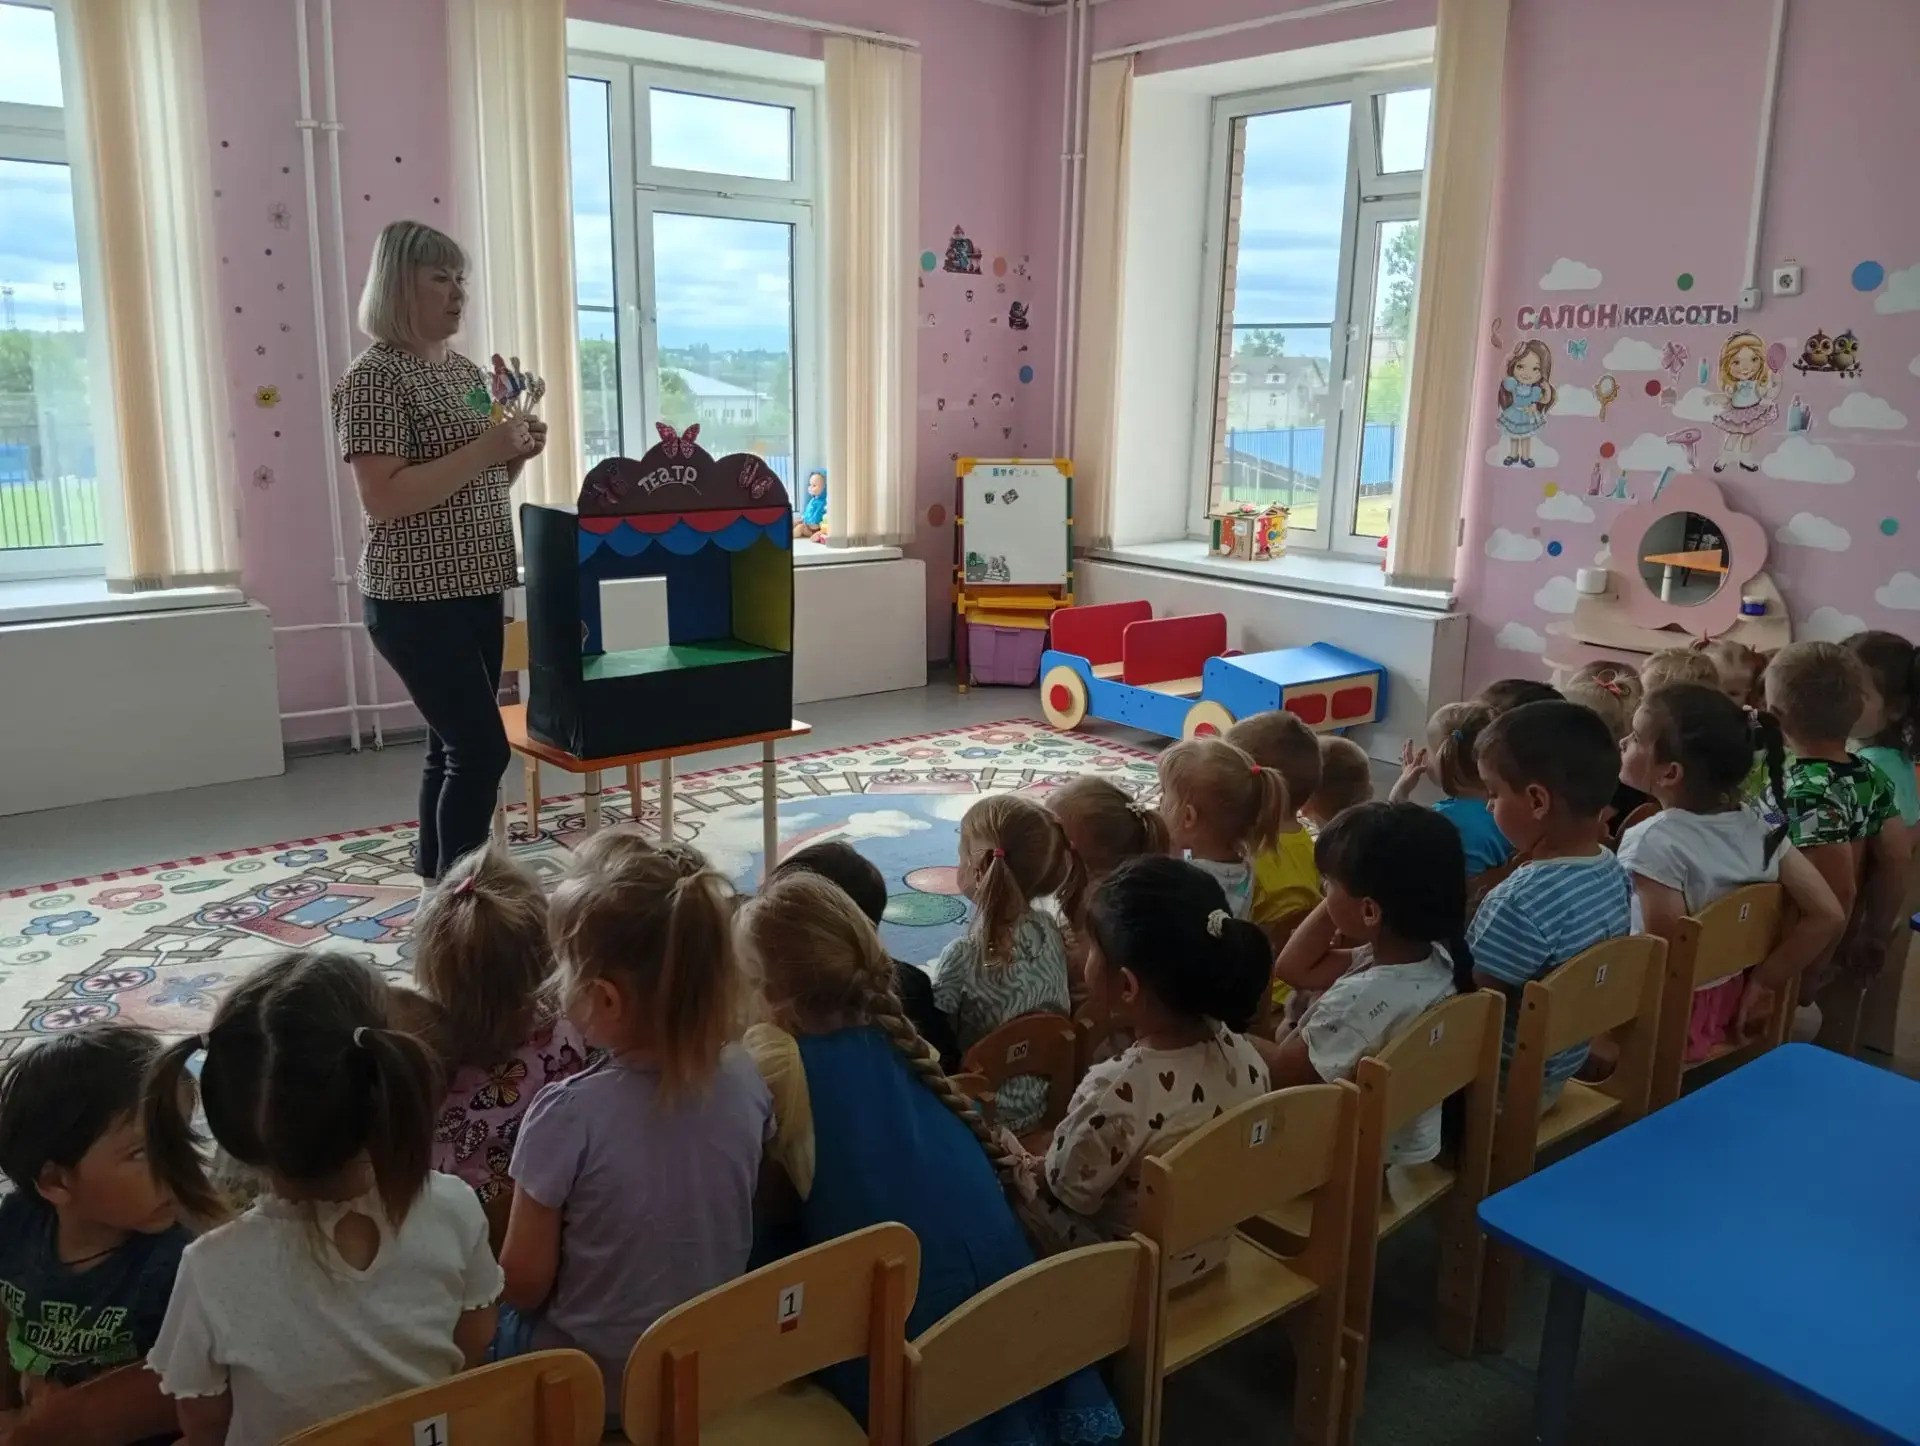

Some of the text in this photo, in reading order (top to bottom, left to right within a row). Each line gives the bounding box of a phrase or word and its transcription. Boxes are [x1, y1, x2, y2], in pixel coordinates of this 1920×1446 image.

[1516, 303, 1739, 331] САЛОН КРАСОТЫ
[1252, 1125, 1262, 1144] 1
[41, 1300, 82, 1326] ER
[783, 1291, 796, 1317] 1
[423, 1422, 444, 1446] 1
